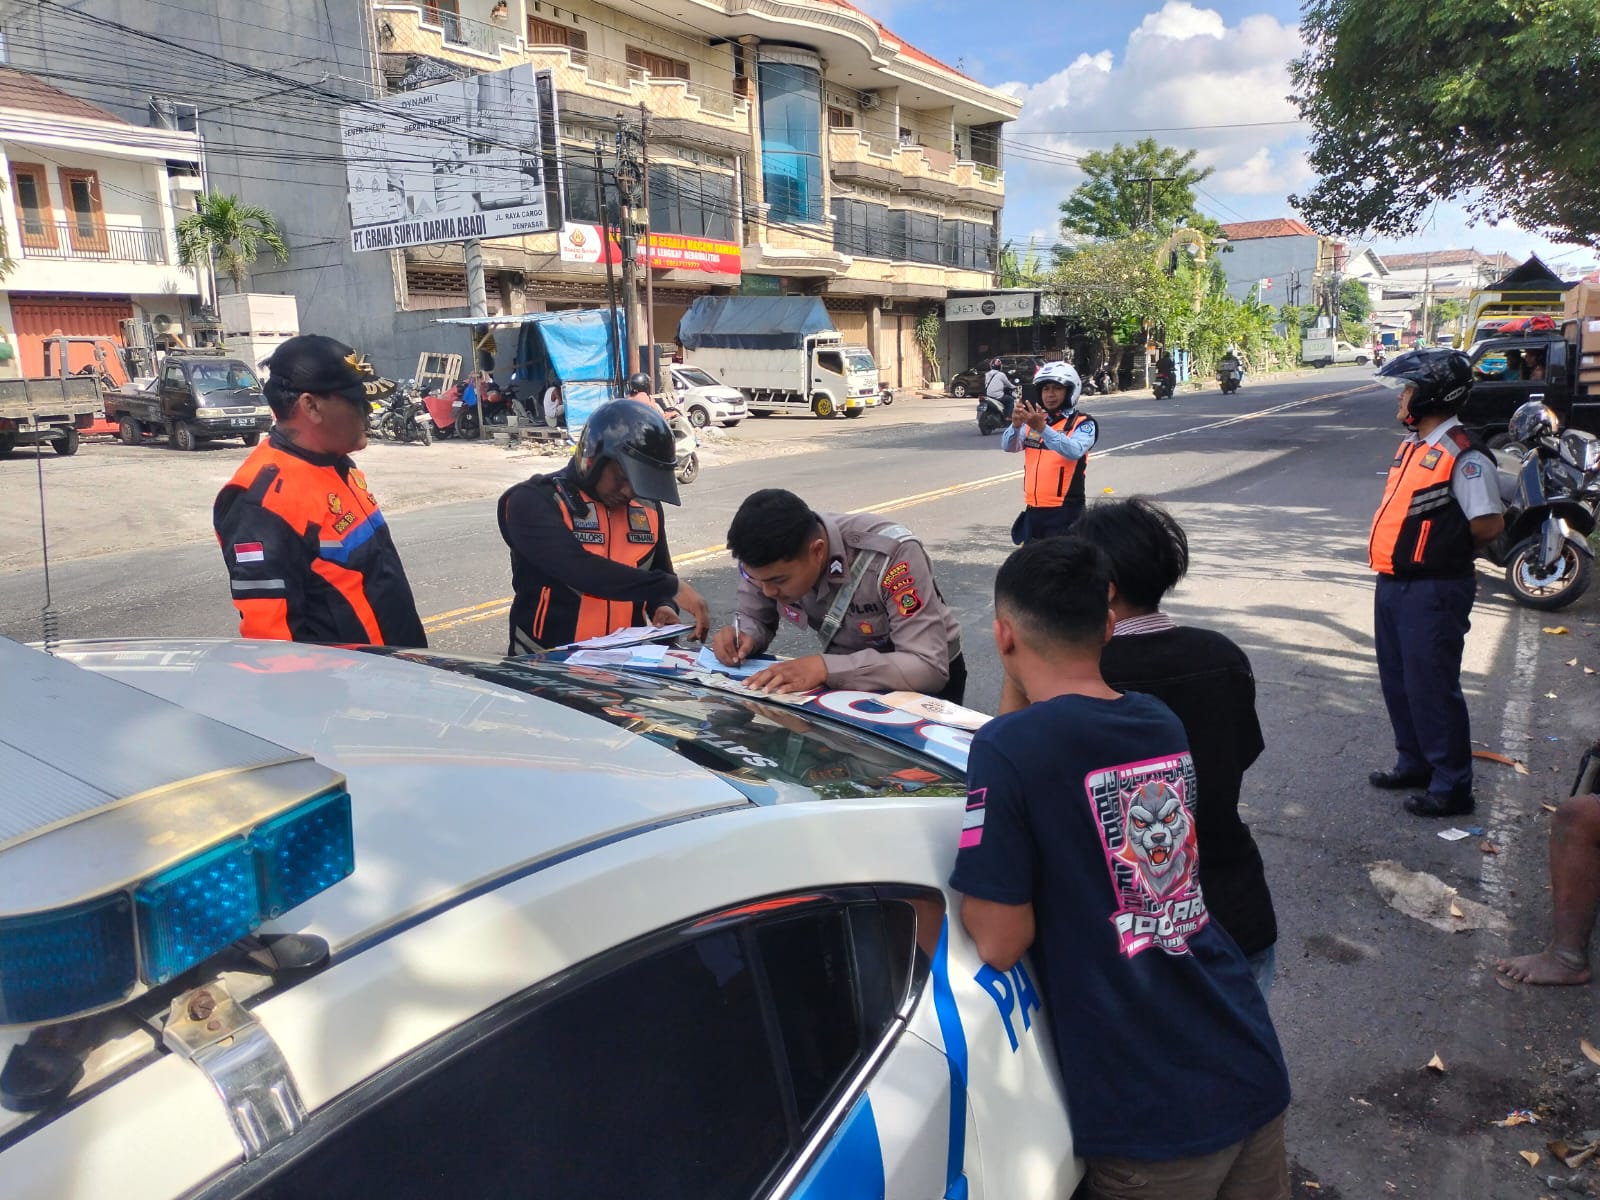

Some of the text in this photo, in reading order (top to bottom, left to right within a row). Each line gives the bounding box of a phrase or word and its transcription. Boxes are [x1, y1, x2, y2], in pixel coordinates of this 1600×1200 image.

[505, 211, 522, 220] RAYA
[522, 209, 543, 219] CARGO
[512, 220, 545, 231] DENPASAR
[353, 213, 487, 251] PT. GRAHA SURYA DARMA ABADI
